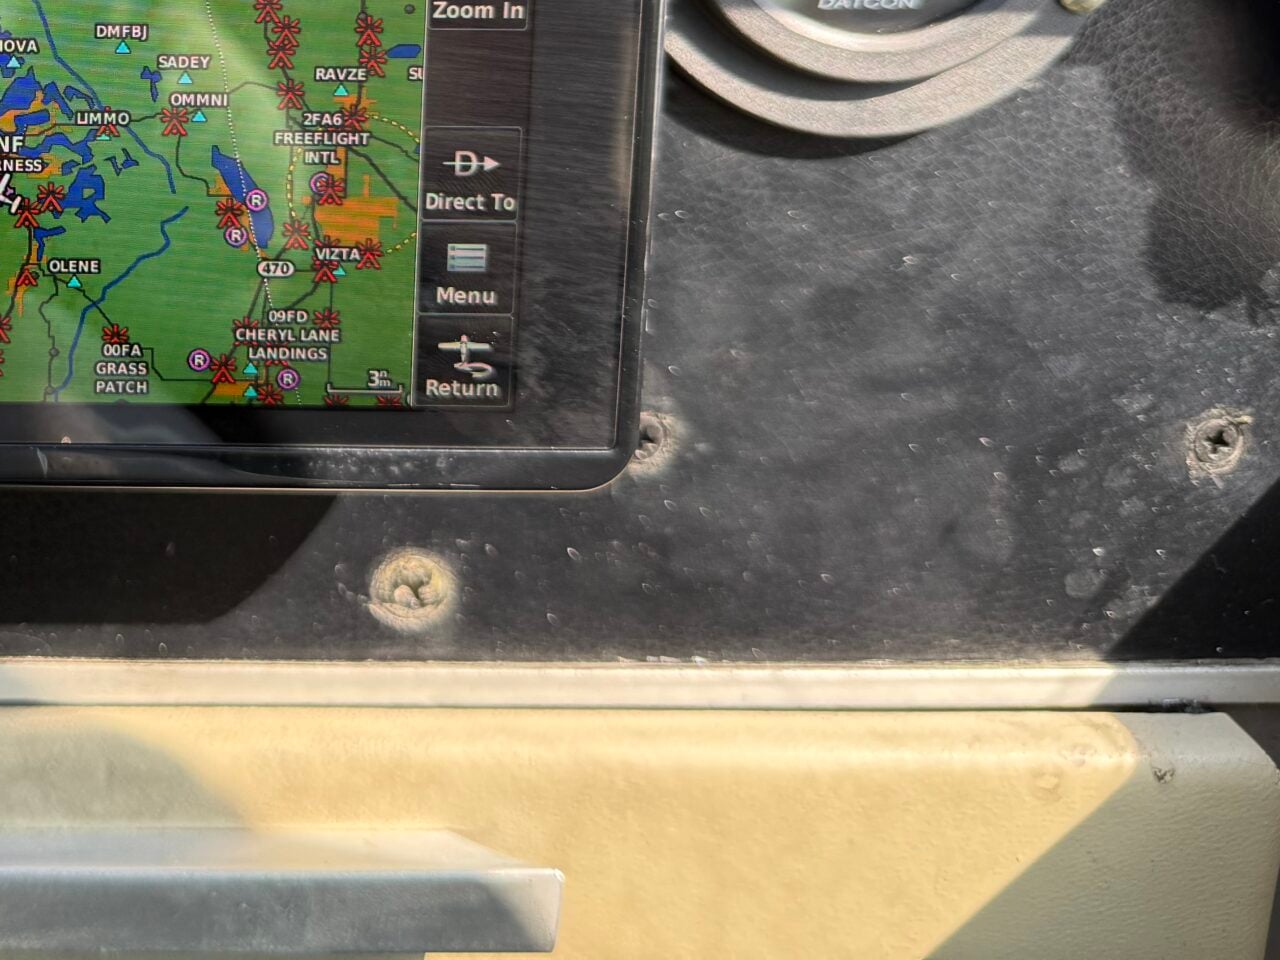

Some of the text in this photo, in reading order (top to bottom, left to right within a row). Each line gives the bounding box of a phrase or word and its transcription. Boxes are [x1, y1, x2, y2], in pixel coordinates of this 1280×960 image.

[433, 2, 525, 19] Zoom In
[96, 25, 148, 39] DMFBJ
[158, 57, 211, 69] SADEY
[315, 68, 367, 81] RAVZE
[170, 94, 228, 106] OMMNI
[303, 113, 343, 126] 2FA6
[274, 132, 370, 145] FREEFLIGHT
[305, 152, 339, 164] INTL
[426, 193, 516, 210] Direct To
[316, 248, 360, 261] VIZTA
[49, 260, 99, 273] OLENE
[262, 263, 289, 275] 470
[436, 287, 496, 305] Menu
[269, 311, 308, 323] 09FD
[236, 328, 340, 342] CHERYL LANE
[248, 348, 328, 360] LANDINGS
[96, 362, 147, 375] GRASS
[96, 380, 147, 393] PATCH
[425, 379, 498, 398] Return
